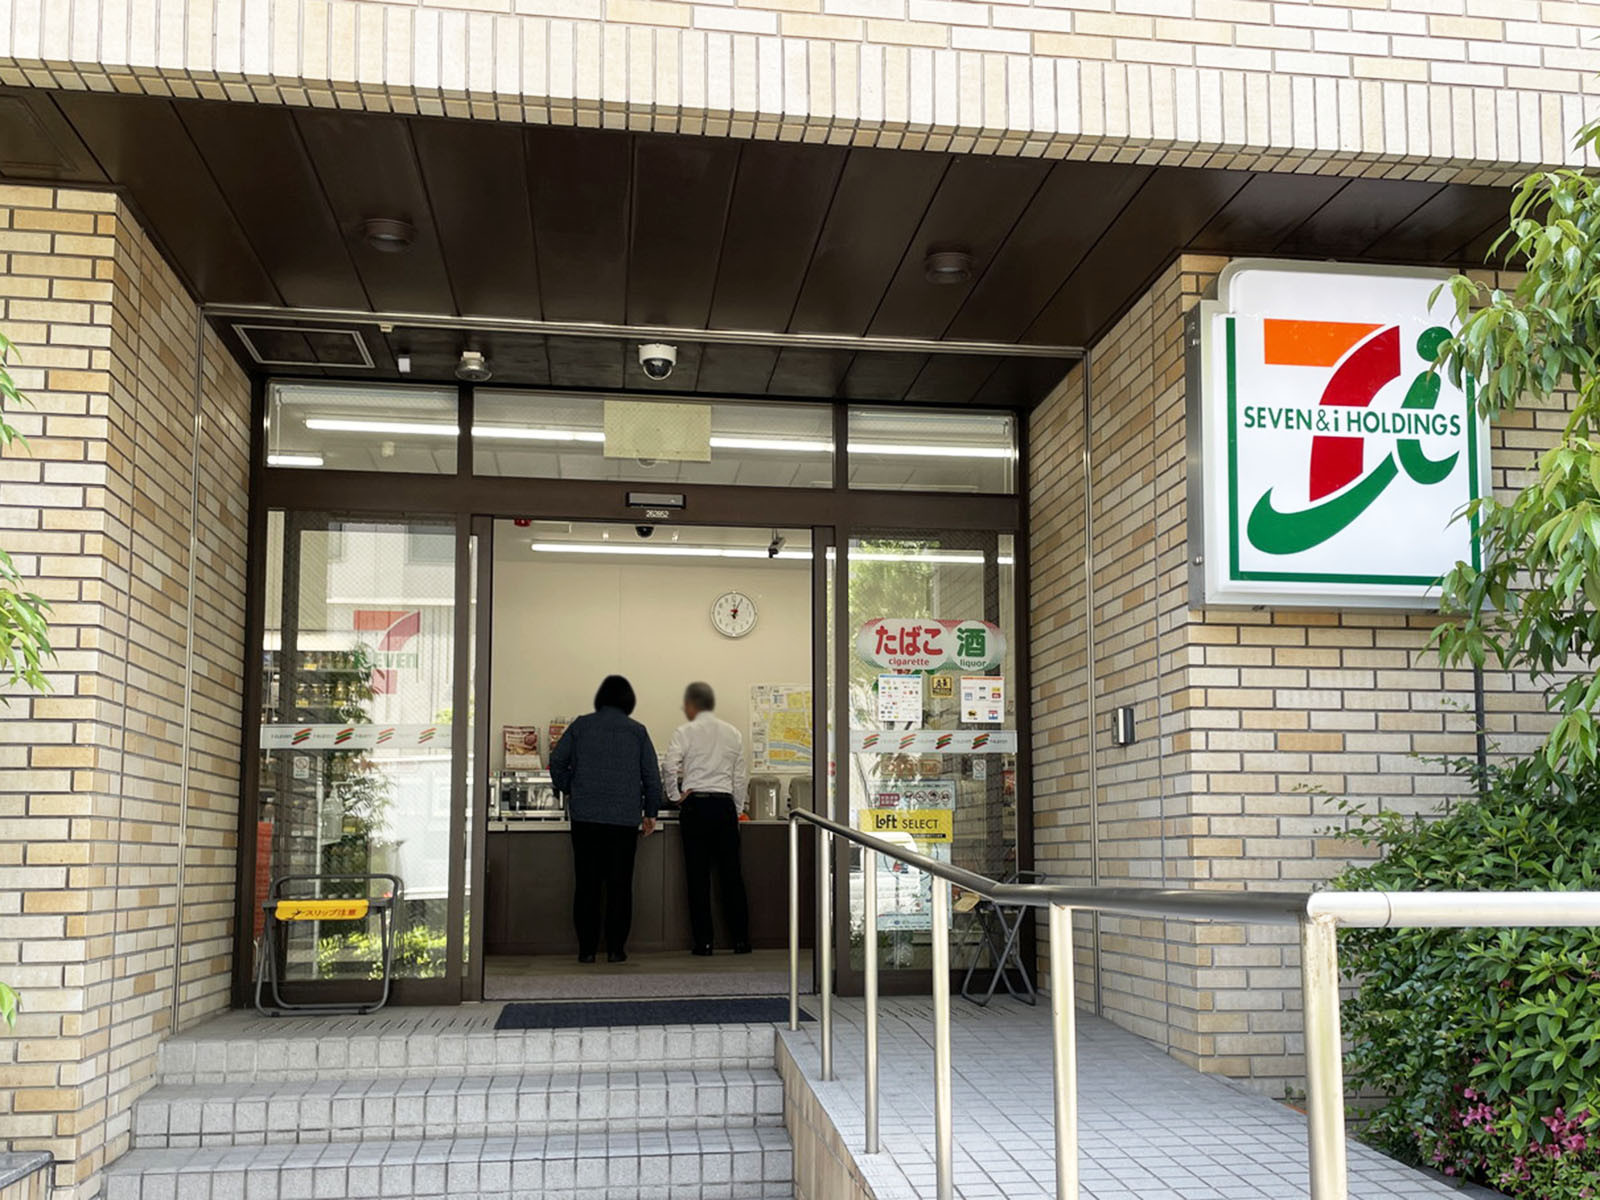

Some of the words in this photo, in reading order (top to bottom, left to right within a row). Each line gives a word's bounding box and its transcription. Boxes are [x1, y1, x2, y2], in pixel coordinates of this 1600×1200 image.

[1347, 411, 1461, 436] HOLDINGS
[875, 625, 943, 656] たばこ
[956, 627, 986, 658] 酒
[888, 657, 930, 666] cigarette
[959, 659, 987, 668] liquor
[902, 819, 939, 829] SELECT
